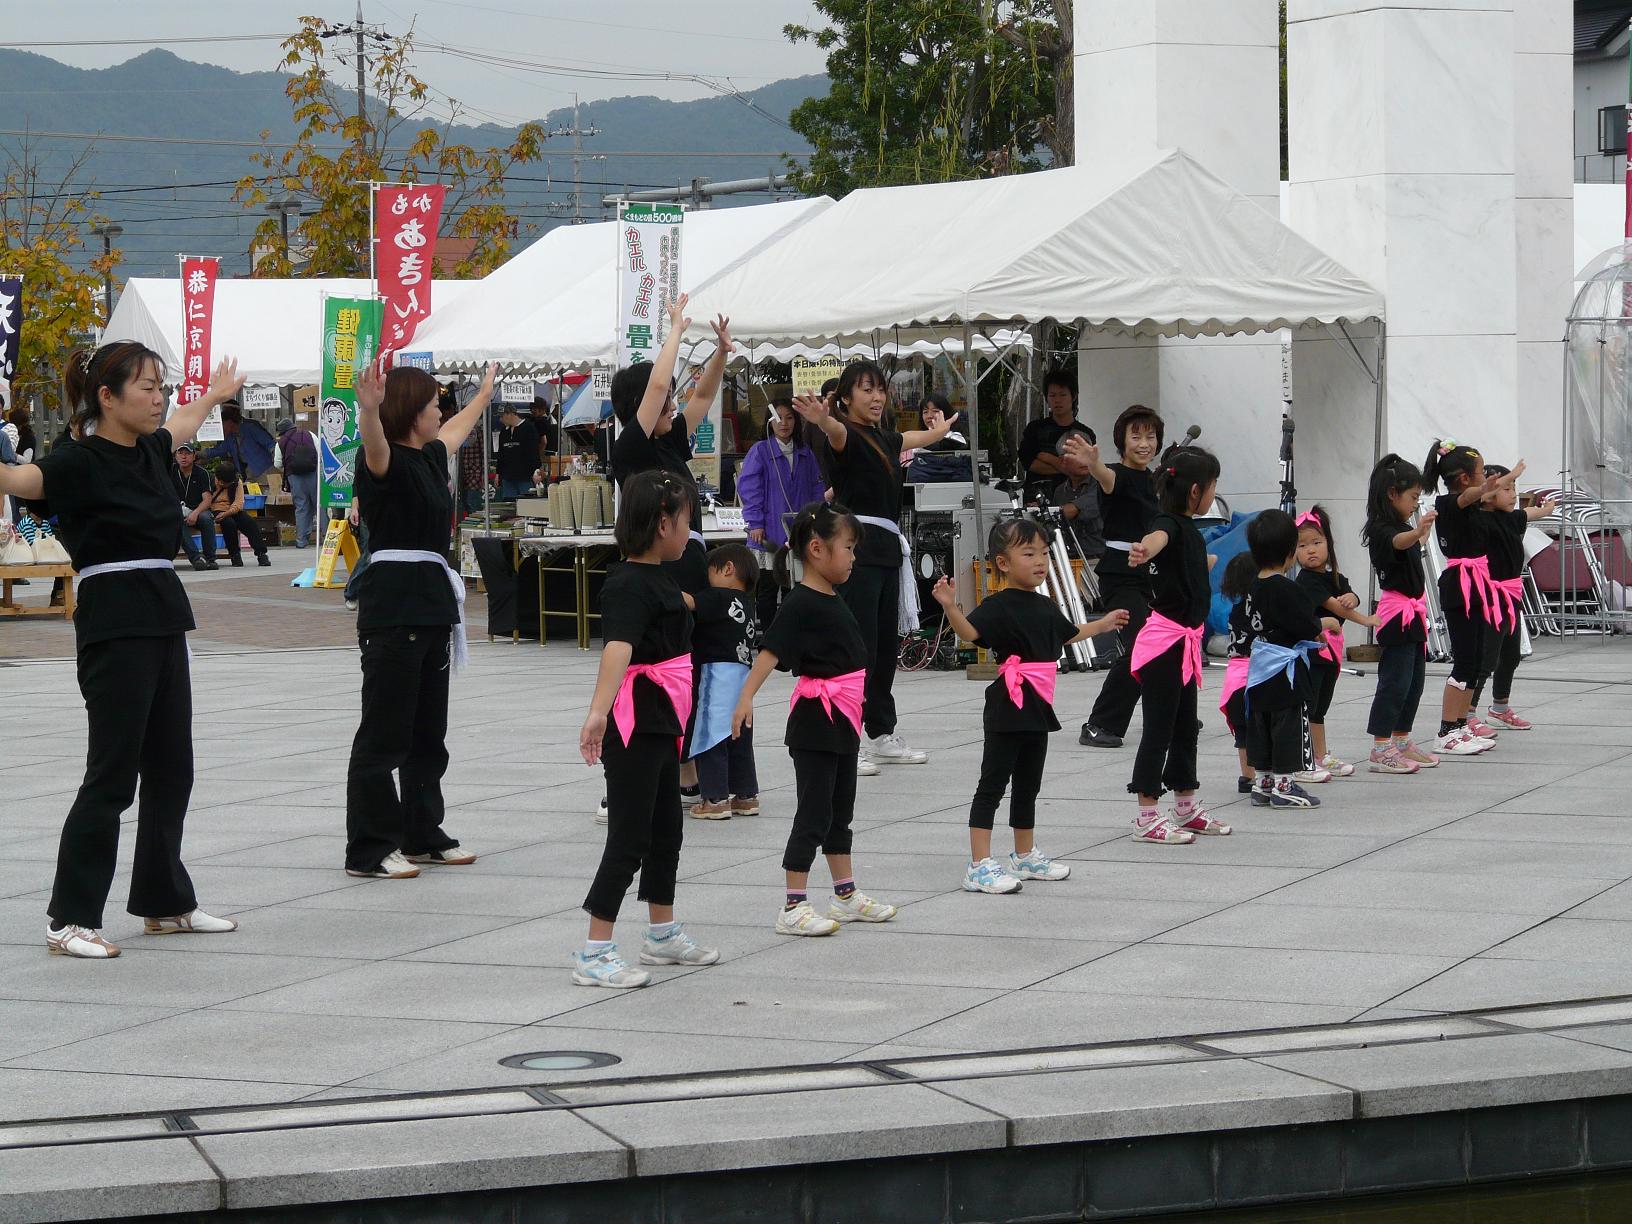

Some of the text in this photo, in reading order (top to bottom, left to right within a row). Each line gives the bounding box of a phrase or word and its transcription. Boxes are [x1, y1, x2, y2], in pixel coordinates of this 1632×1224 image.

[625, 226, 647, 272] カエル
[632, 273, 655, 319] カエル
[184, 269, 209, 402] 恭仁京朝市
